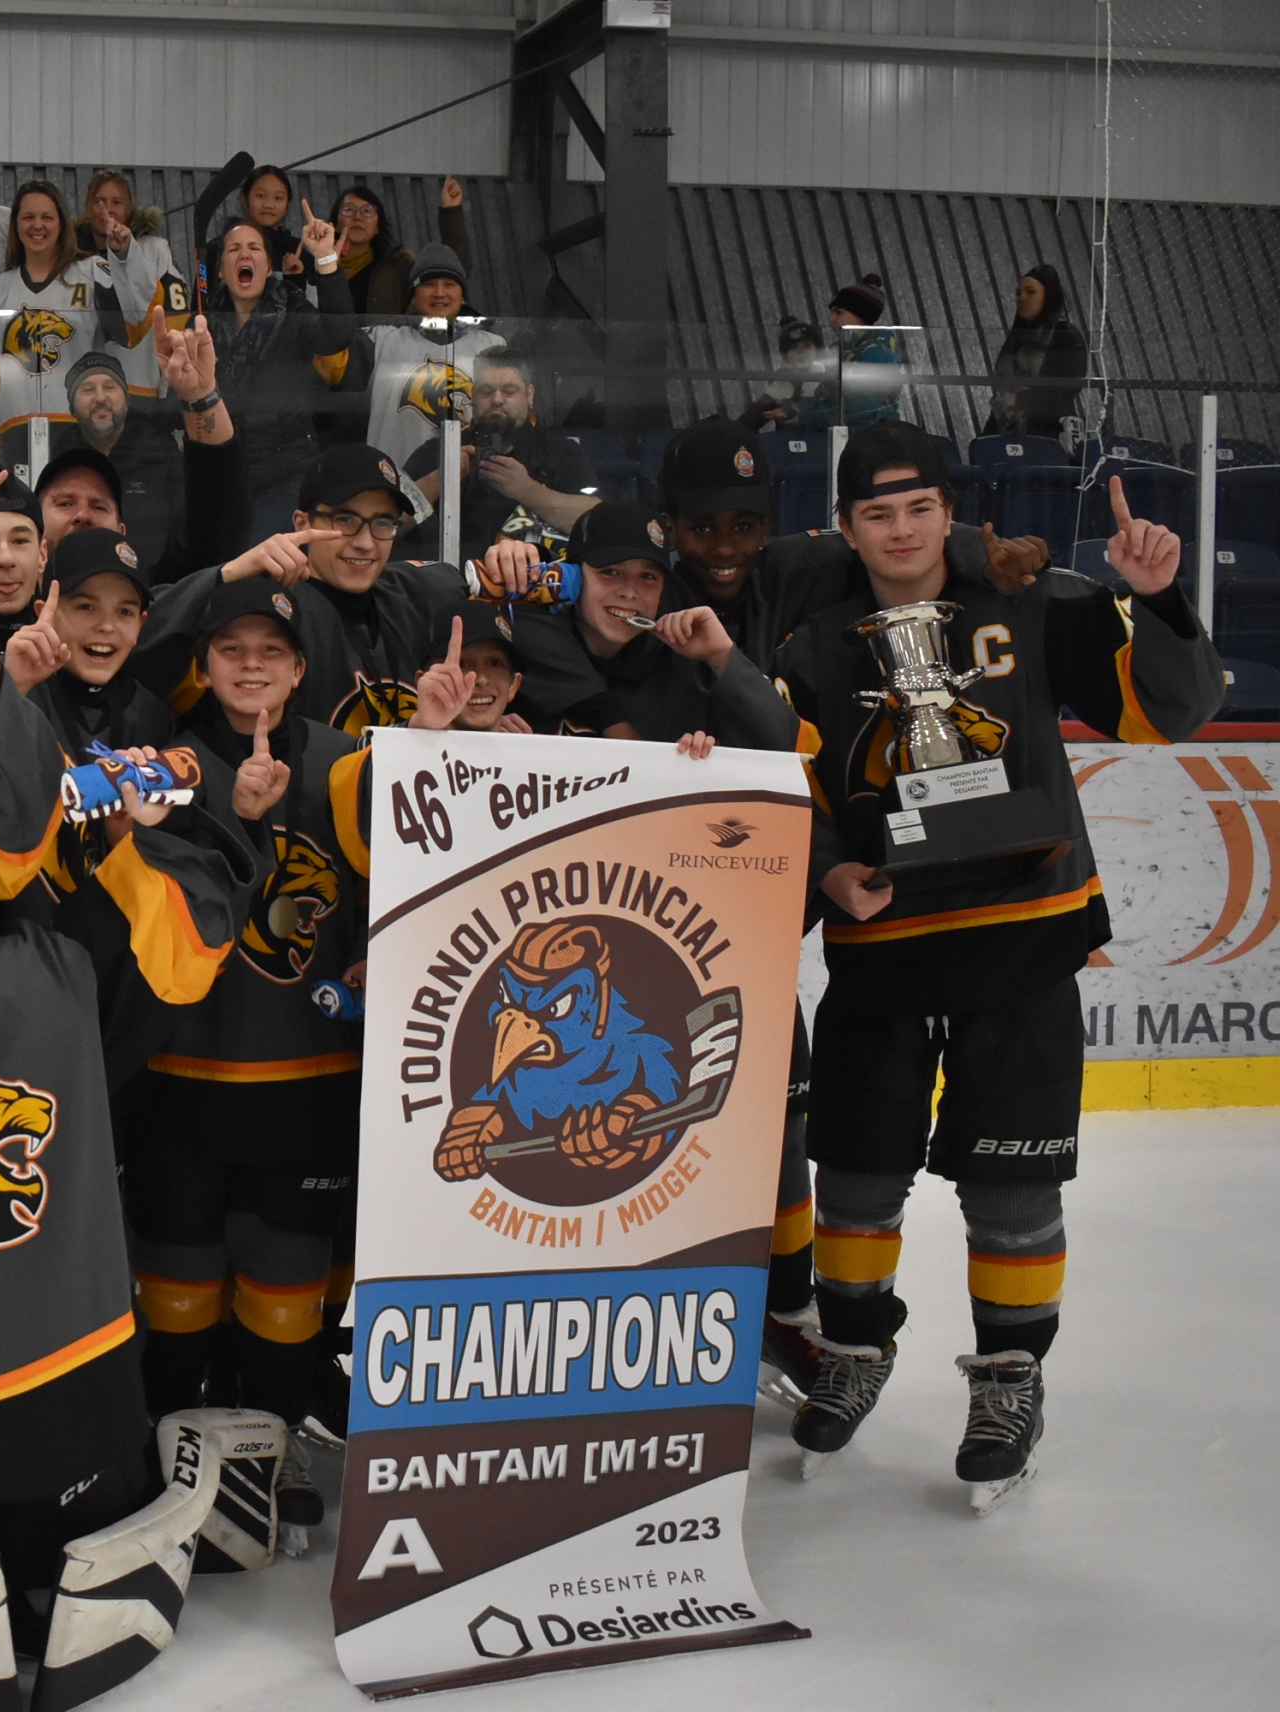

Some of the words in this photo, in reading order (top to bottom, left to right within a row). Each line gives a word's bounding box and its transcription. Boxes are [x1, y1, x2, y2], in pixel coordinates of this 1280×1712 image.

[169, 282, 191, 311] 6
[972, 623, 1016, 678] C
[936, 771, 971, 783] CHAMPION
[972, 766, 999, 776] BANTAM
[953, 784, 989, 795] DESJARDINS
[667, 852, 789, 875] PRINCEVILLE
[401, 908, 501, 1123] TOURNOI
[501, 860, 732, 981] PROVINCIAL
[469, 1187, 583, 1248] BANTAM
[619, 1135, 712, 1235] MIDGET
[366, 1288, 738, 1407] CHAMPIONS
[172, 1425, 202, 1489] CCM
[367, 1444, 569, 1495] BANTAM
[583, 1432, 706, 1485] [M15]
[356, 1516, 445, 1582] A
[634, 1515, 722, 1548] 2023
[548, 1570, 658, 1599] PRÉSENTÉ
[667, 1567, 707, 1587] PAR
[536, 1596, 758, 1648] Desjardins
